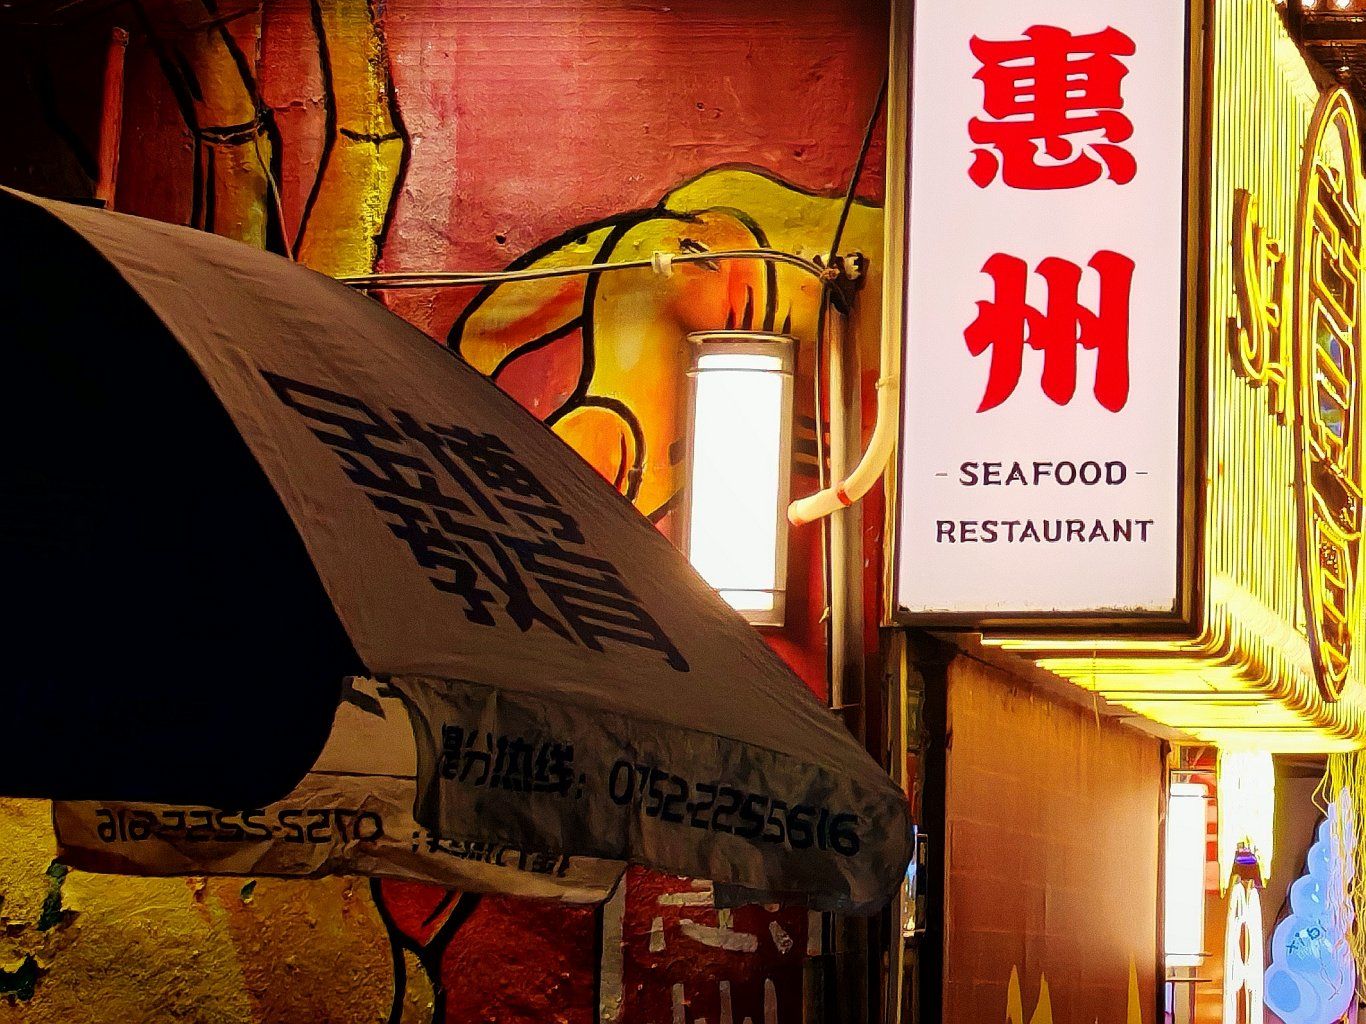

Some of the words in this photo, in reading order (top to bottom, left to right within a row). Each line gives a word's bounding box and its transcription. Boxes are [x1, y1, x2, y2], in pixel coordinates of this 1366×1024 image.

[964, 25, 1138, 414] 惠州
[959, 461, 1127, 487] SEAFOOD
[935, 518, 1154, 544] RESTAURANT
